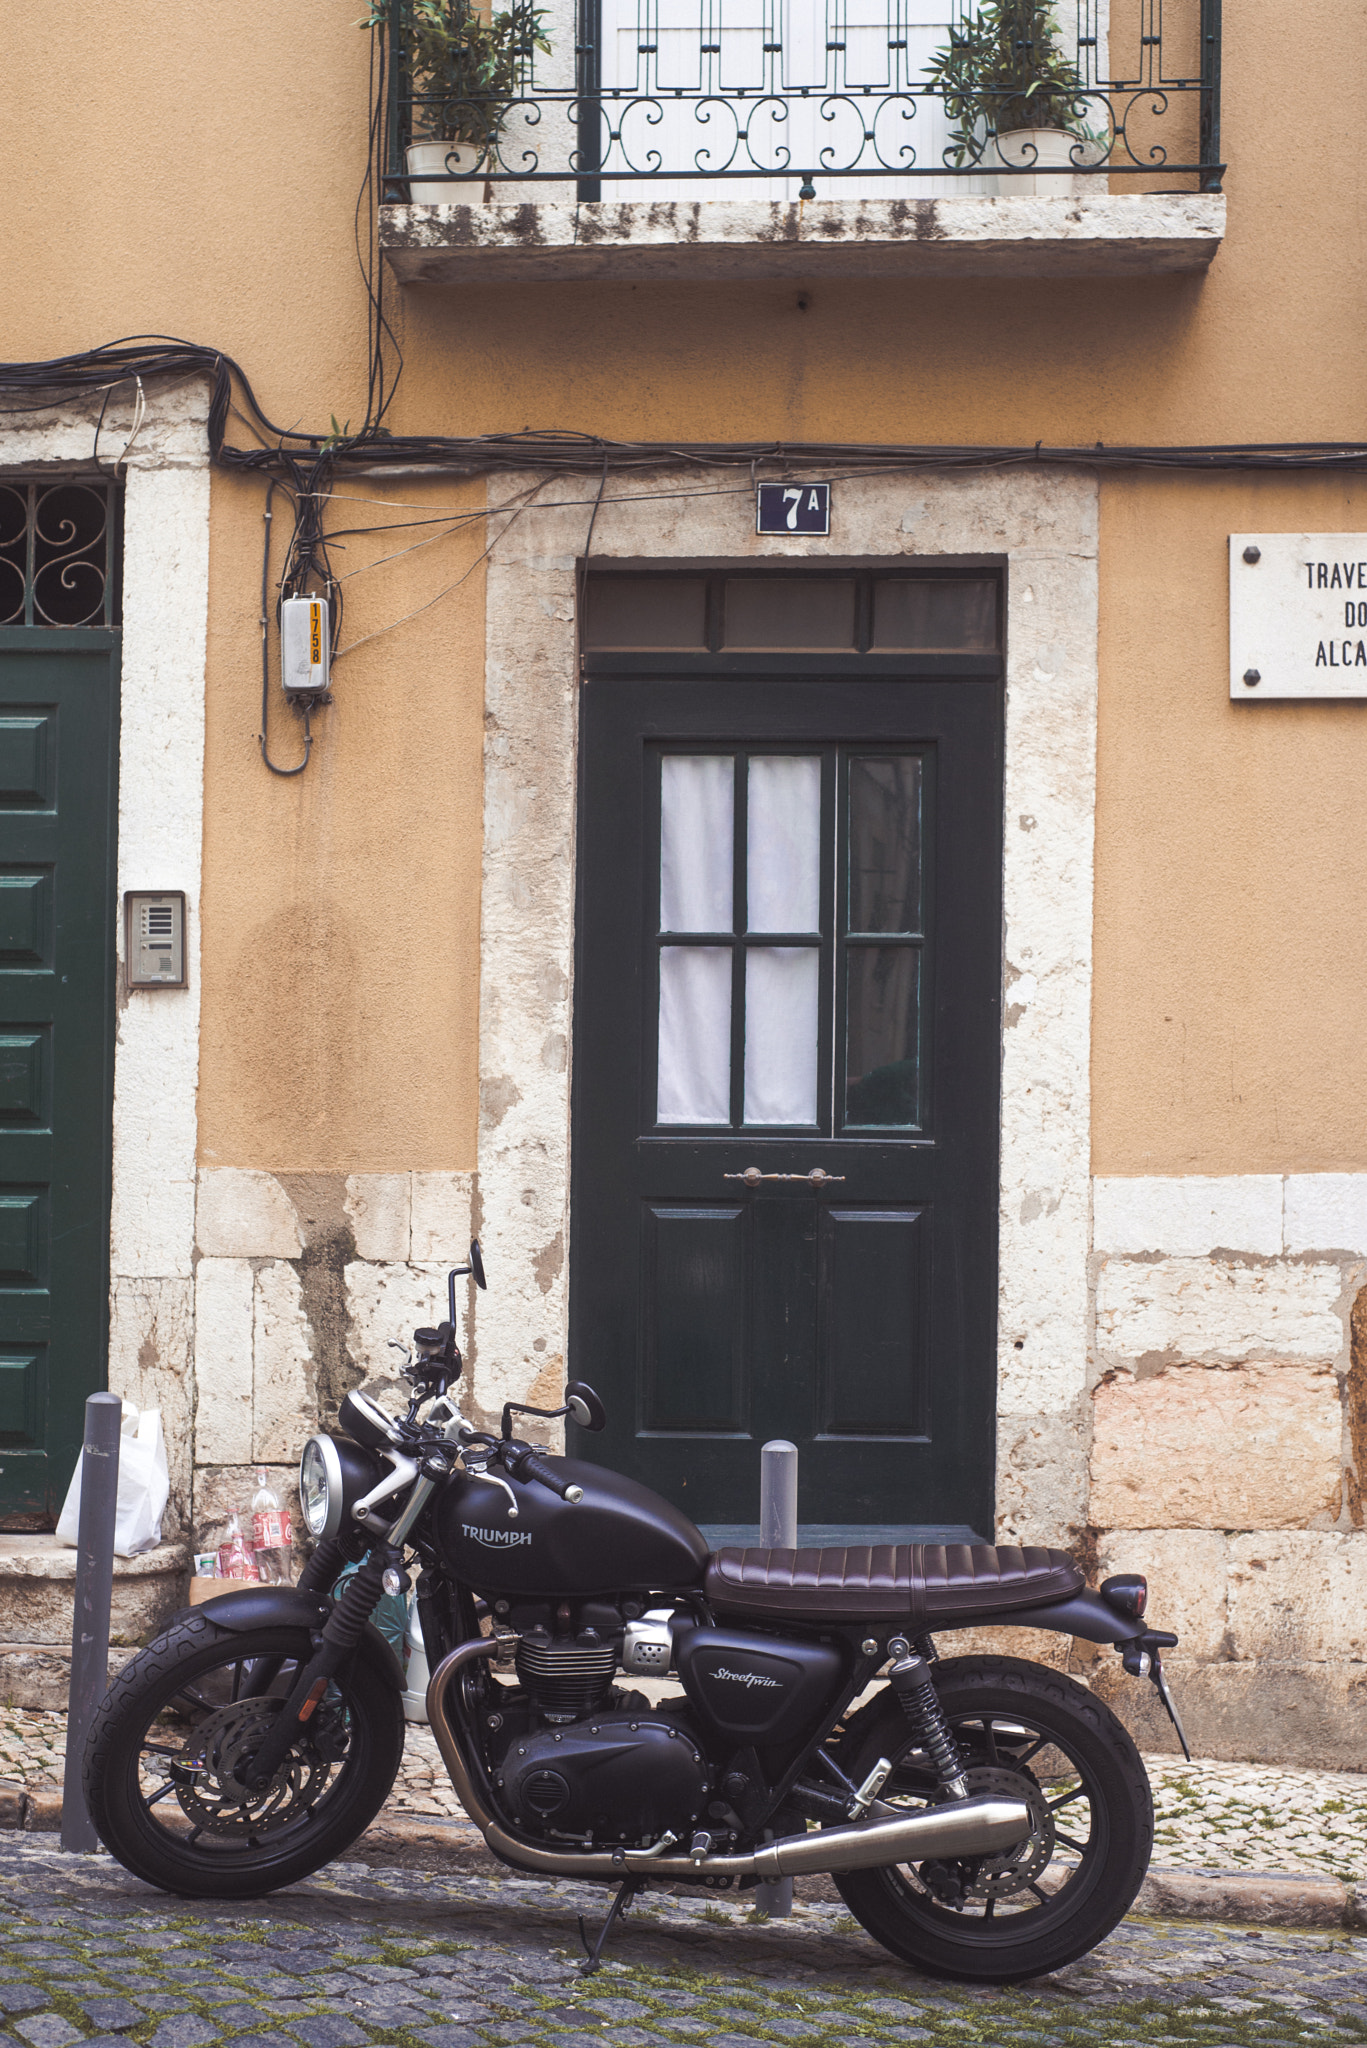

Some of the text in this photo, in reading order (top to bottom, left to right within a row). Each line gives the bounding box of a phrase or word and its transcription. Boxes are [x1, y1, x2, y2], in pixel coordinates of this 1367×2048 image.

[1304, 562, 1367, 589] TRAVE
[1344, 601, 1367, 628] DO
[311, 602, 320, 663] 1758
[1314, 640, 1367, 667] ALCA
[461, 1523, 532, 1549] TRIUMPH
